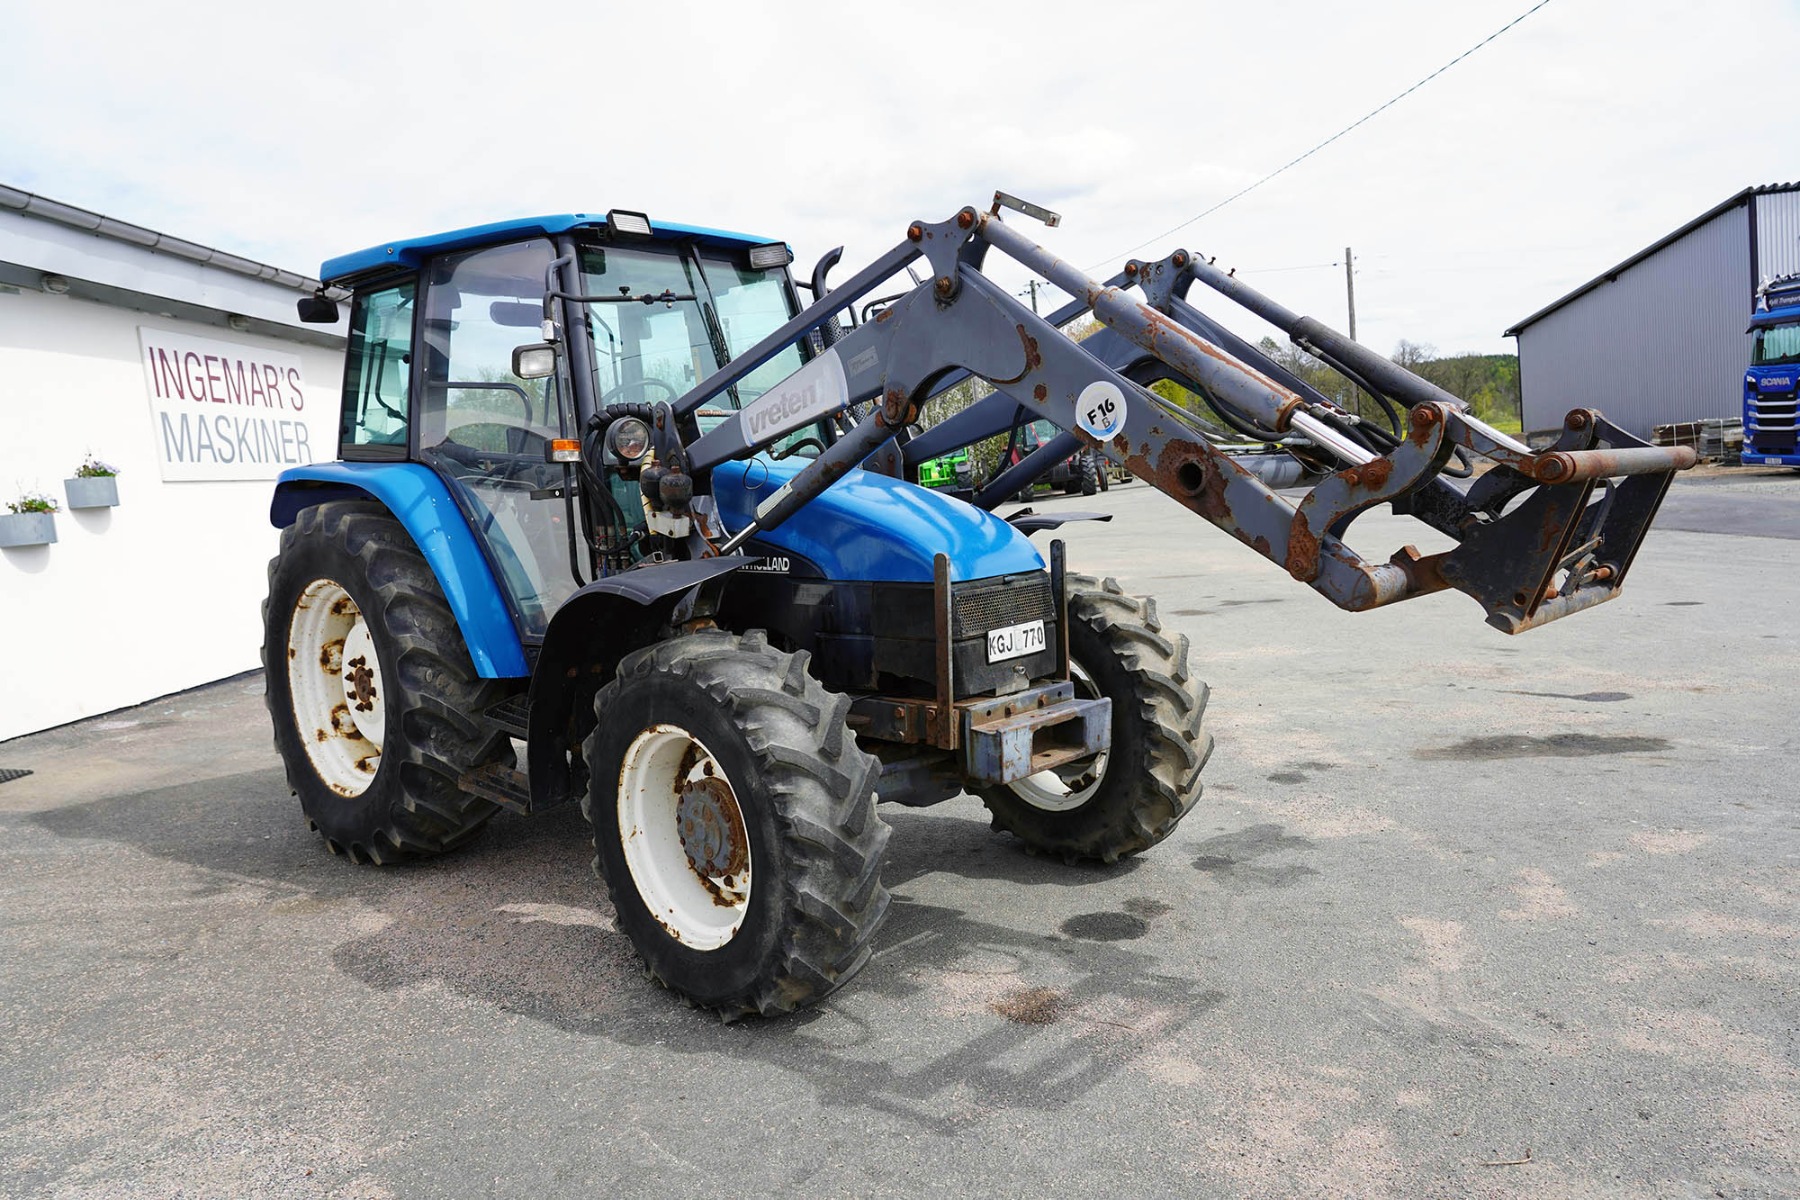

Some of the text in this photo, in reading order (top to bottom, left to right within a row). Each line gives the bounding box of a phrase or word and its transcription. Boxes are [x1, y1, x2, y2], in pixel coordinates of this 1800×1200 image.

[149, 346, 304, 411] INGEMAR'S
[1760, 377, 1790, 386] SCANIA
[749, 385, 816, 435] vreten
[160, 411, 312, 464] MASKINER
[989, 626, 1044, 656] KGJ 770
